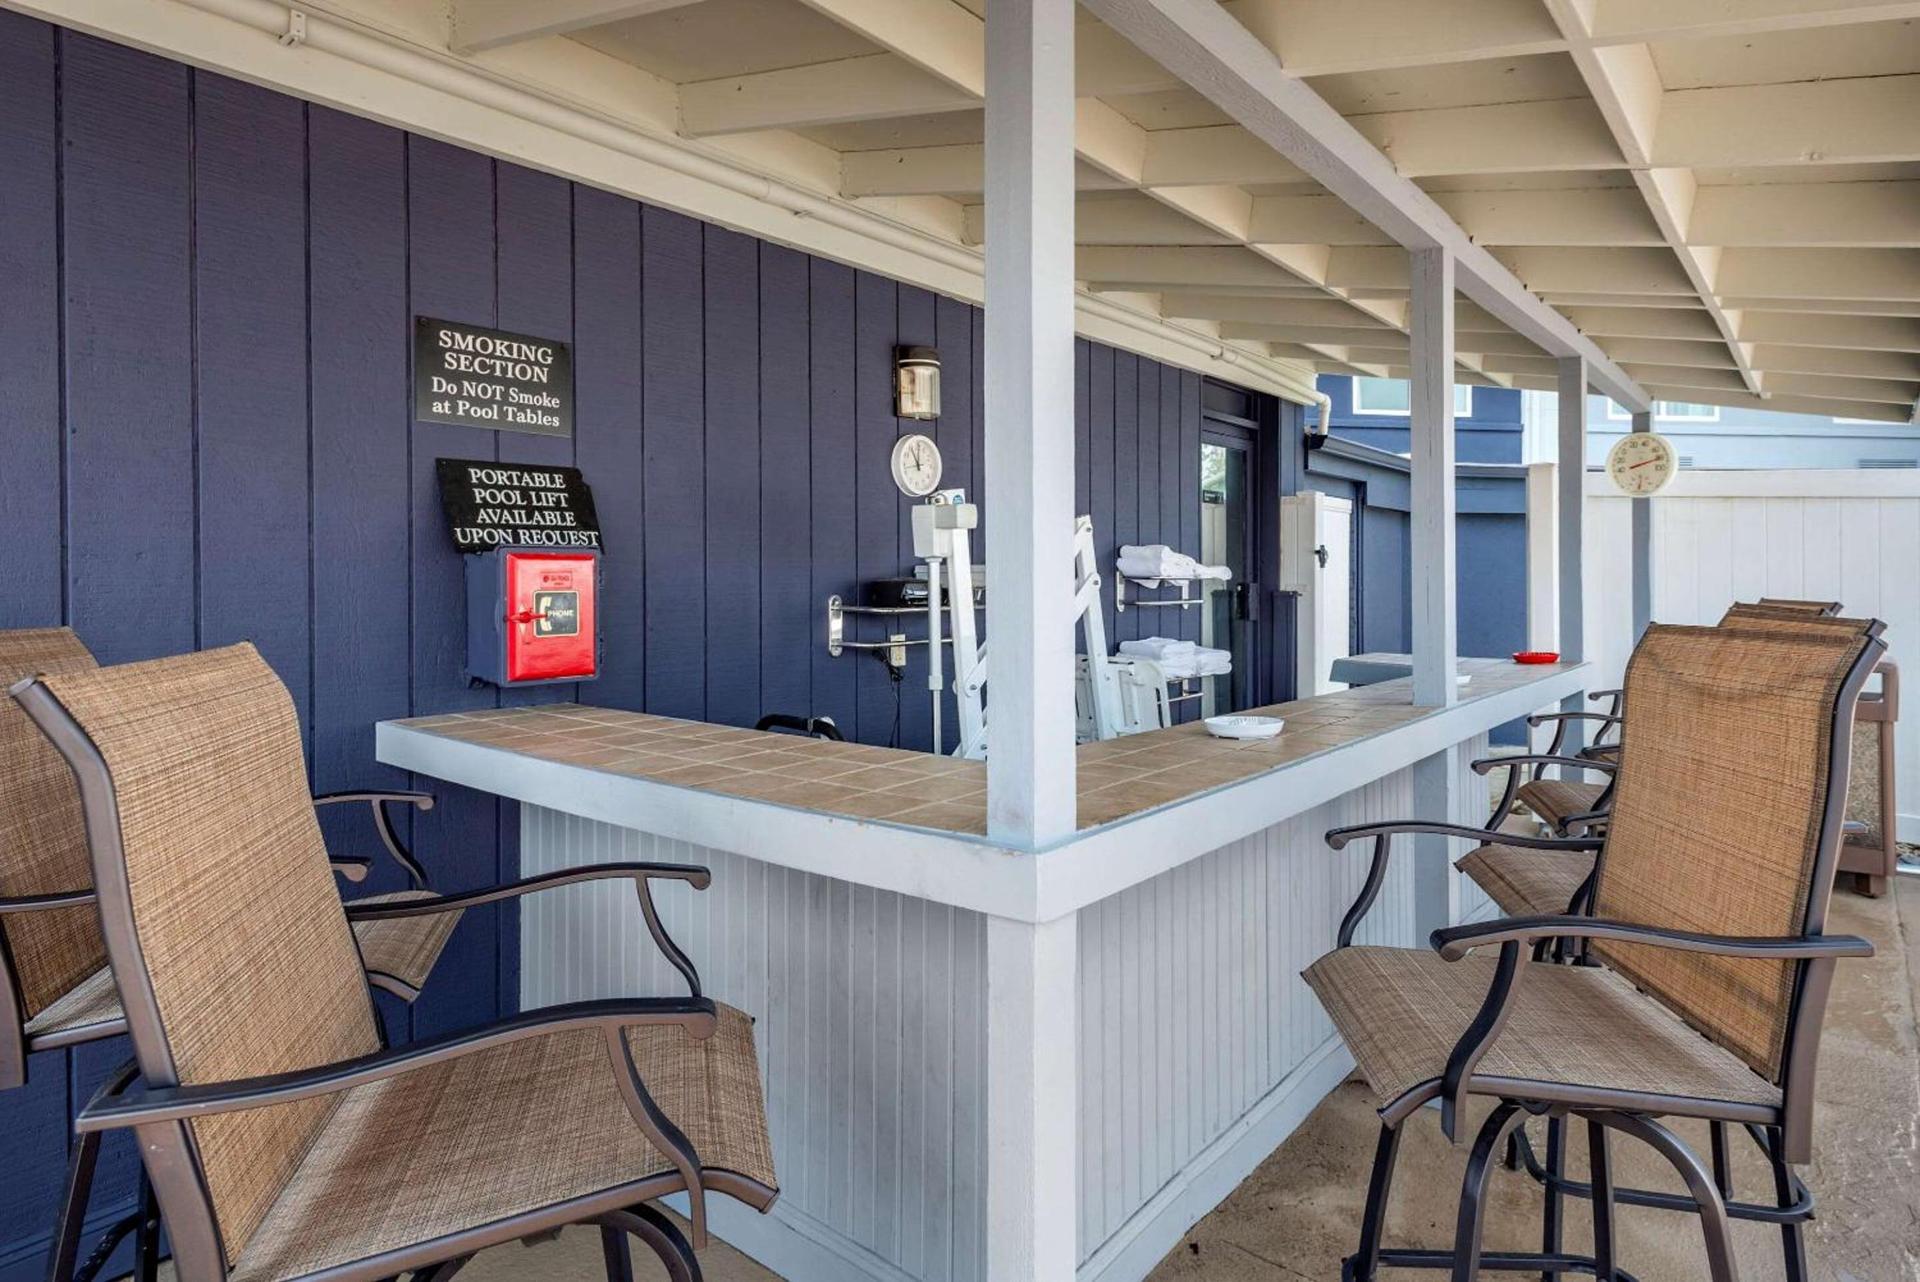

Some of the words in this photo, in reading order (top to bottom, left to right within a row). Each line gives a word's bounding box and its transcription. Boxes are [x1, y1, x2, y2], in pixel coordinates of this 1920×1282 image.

[439, 330, 553, 364] SMOKING
[444, 351, 549, 383] SECTION
[432, 376, 457, 395] Do
[462, 380, 505, 401] NOT
[508, 387, 560, 408] Smoke
[432, 400, 452, 415] at
[456, 400, 499, 420] Pool
[503, 406, 560, 427] Tables
[468, 467, 566, 489] PORTABLE
[472, 488, 527, 506] POOL
[529, 491, 568, 507] LIFT
[476, 508, 577, 527] AVAILABLE
[454, 527, 514, 545] UPON
[517, 529, 599, 546] REQUEST
[547, 608, 575, 618] PHONE
